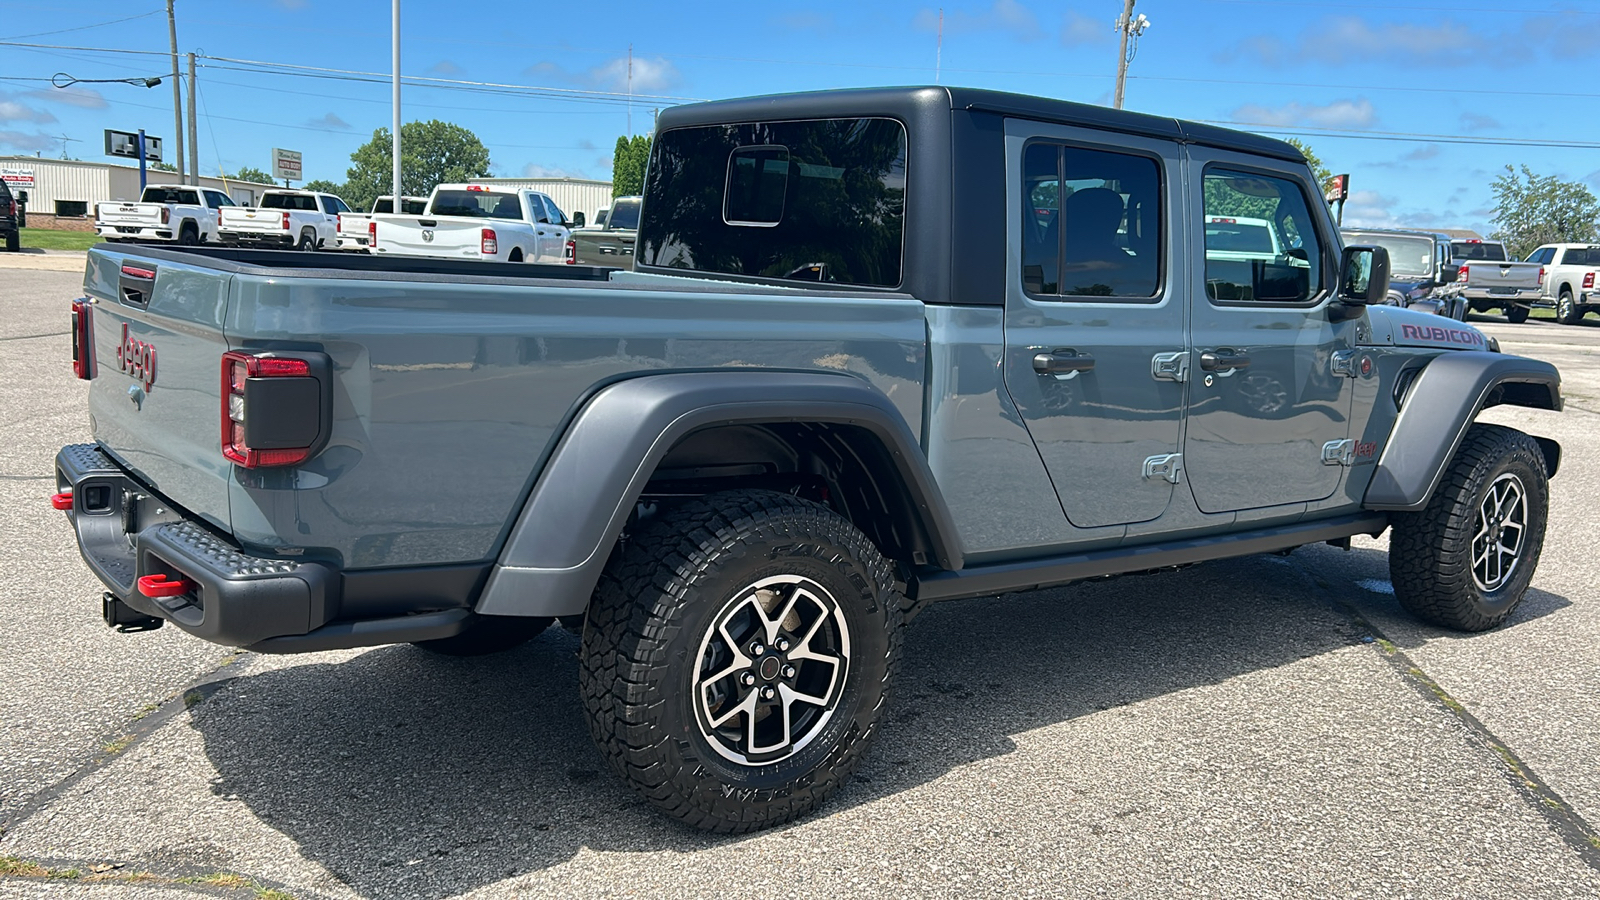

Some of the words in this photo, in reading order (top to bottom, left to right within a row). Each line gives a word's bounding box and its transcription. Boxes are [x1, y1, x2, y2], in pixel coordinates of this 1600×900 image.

[279, 160, 290, 168] AUTO
[599, 246, 634, 256] RA
[1401, 324, 1485, 347] RUBICON
[115, 321, 157, 393] Jeep
[1350, 439, 1377, 459] Jeep
